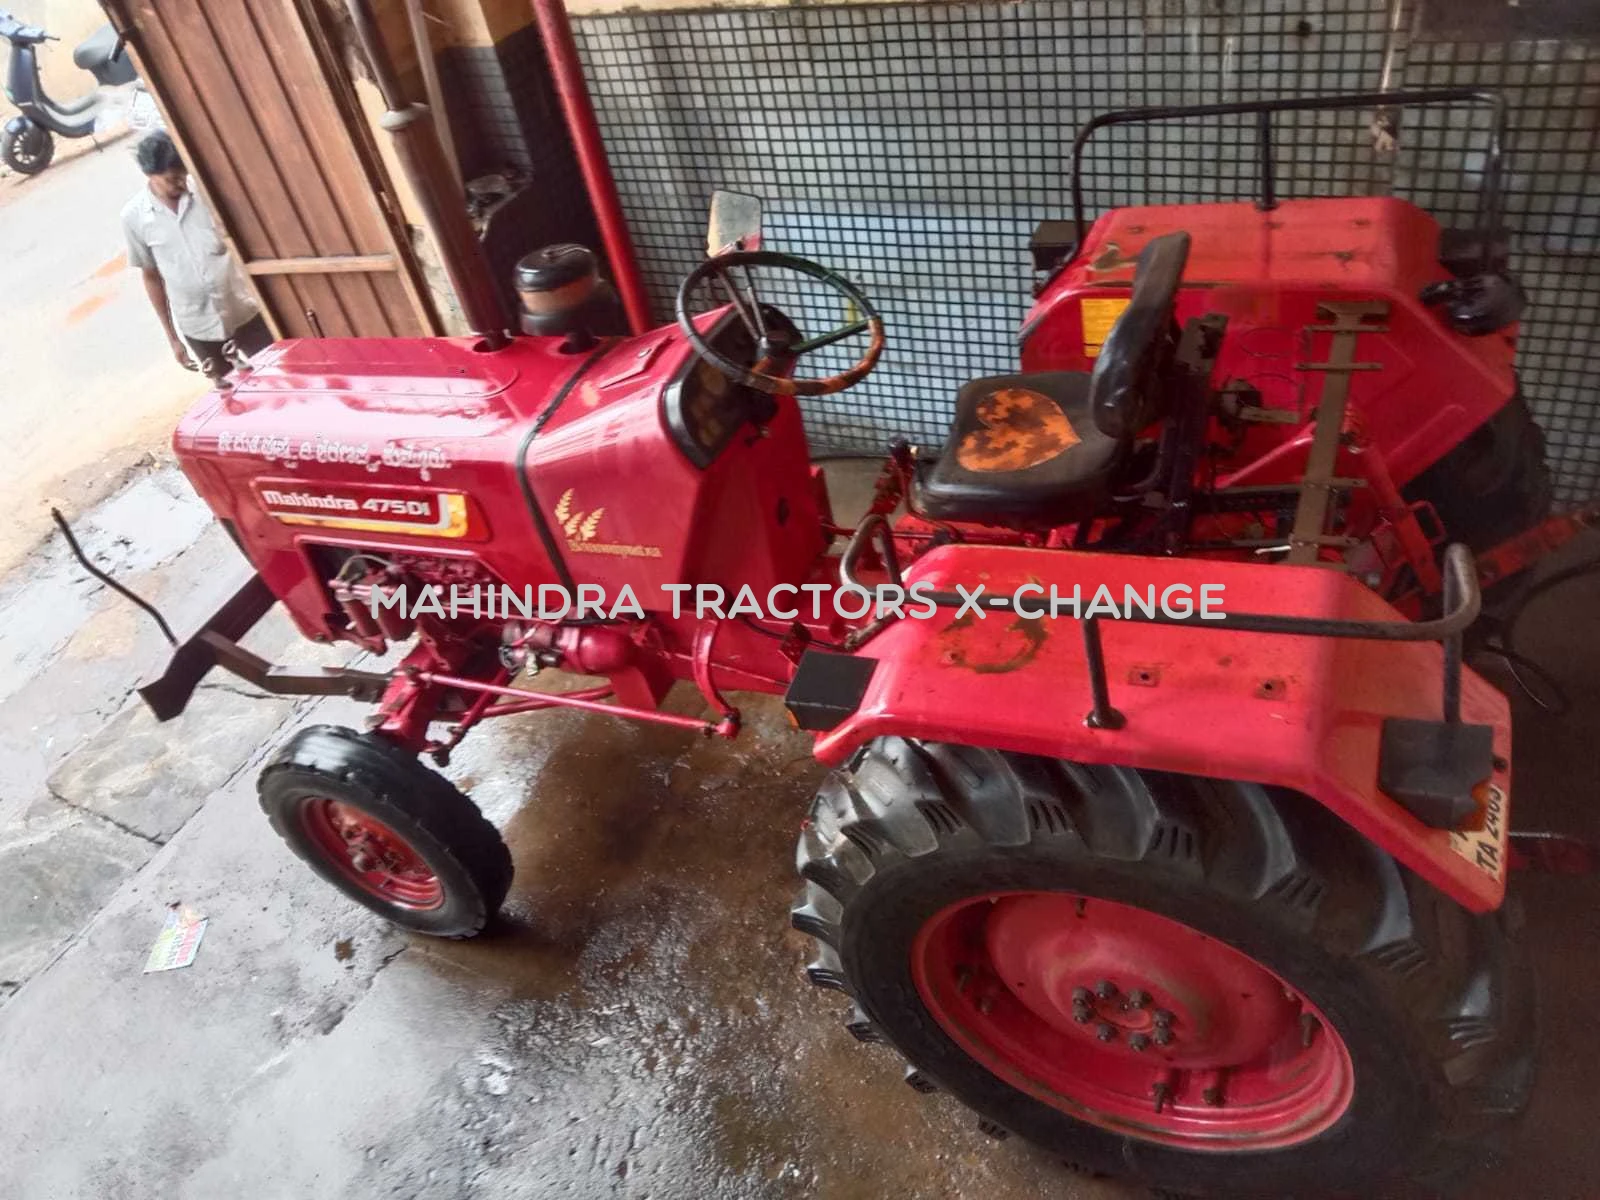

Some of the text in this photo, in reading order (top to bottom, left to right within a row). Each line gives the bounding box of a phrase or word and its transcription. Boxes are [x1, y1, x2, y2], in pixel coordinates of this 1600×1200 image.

[261, 490, 431, 517] Mahindra 475DI
[1476, 840, 1499, 872] TA
